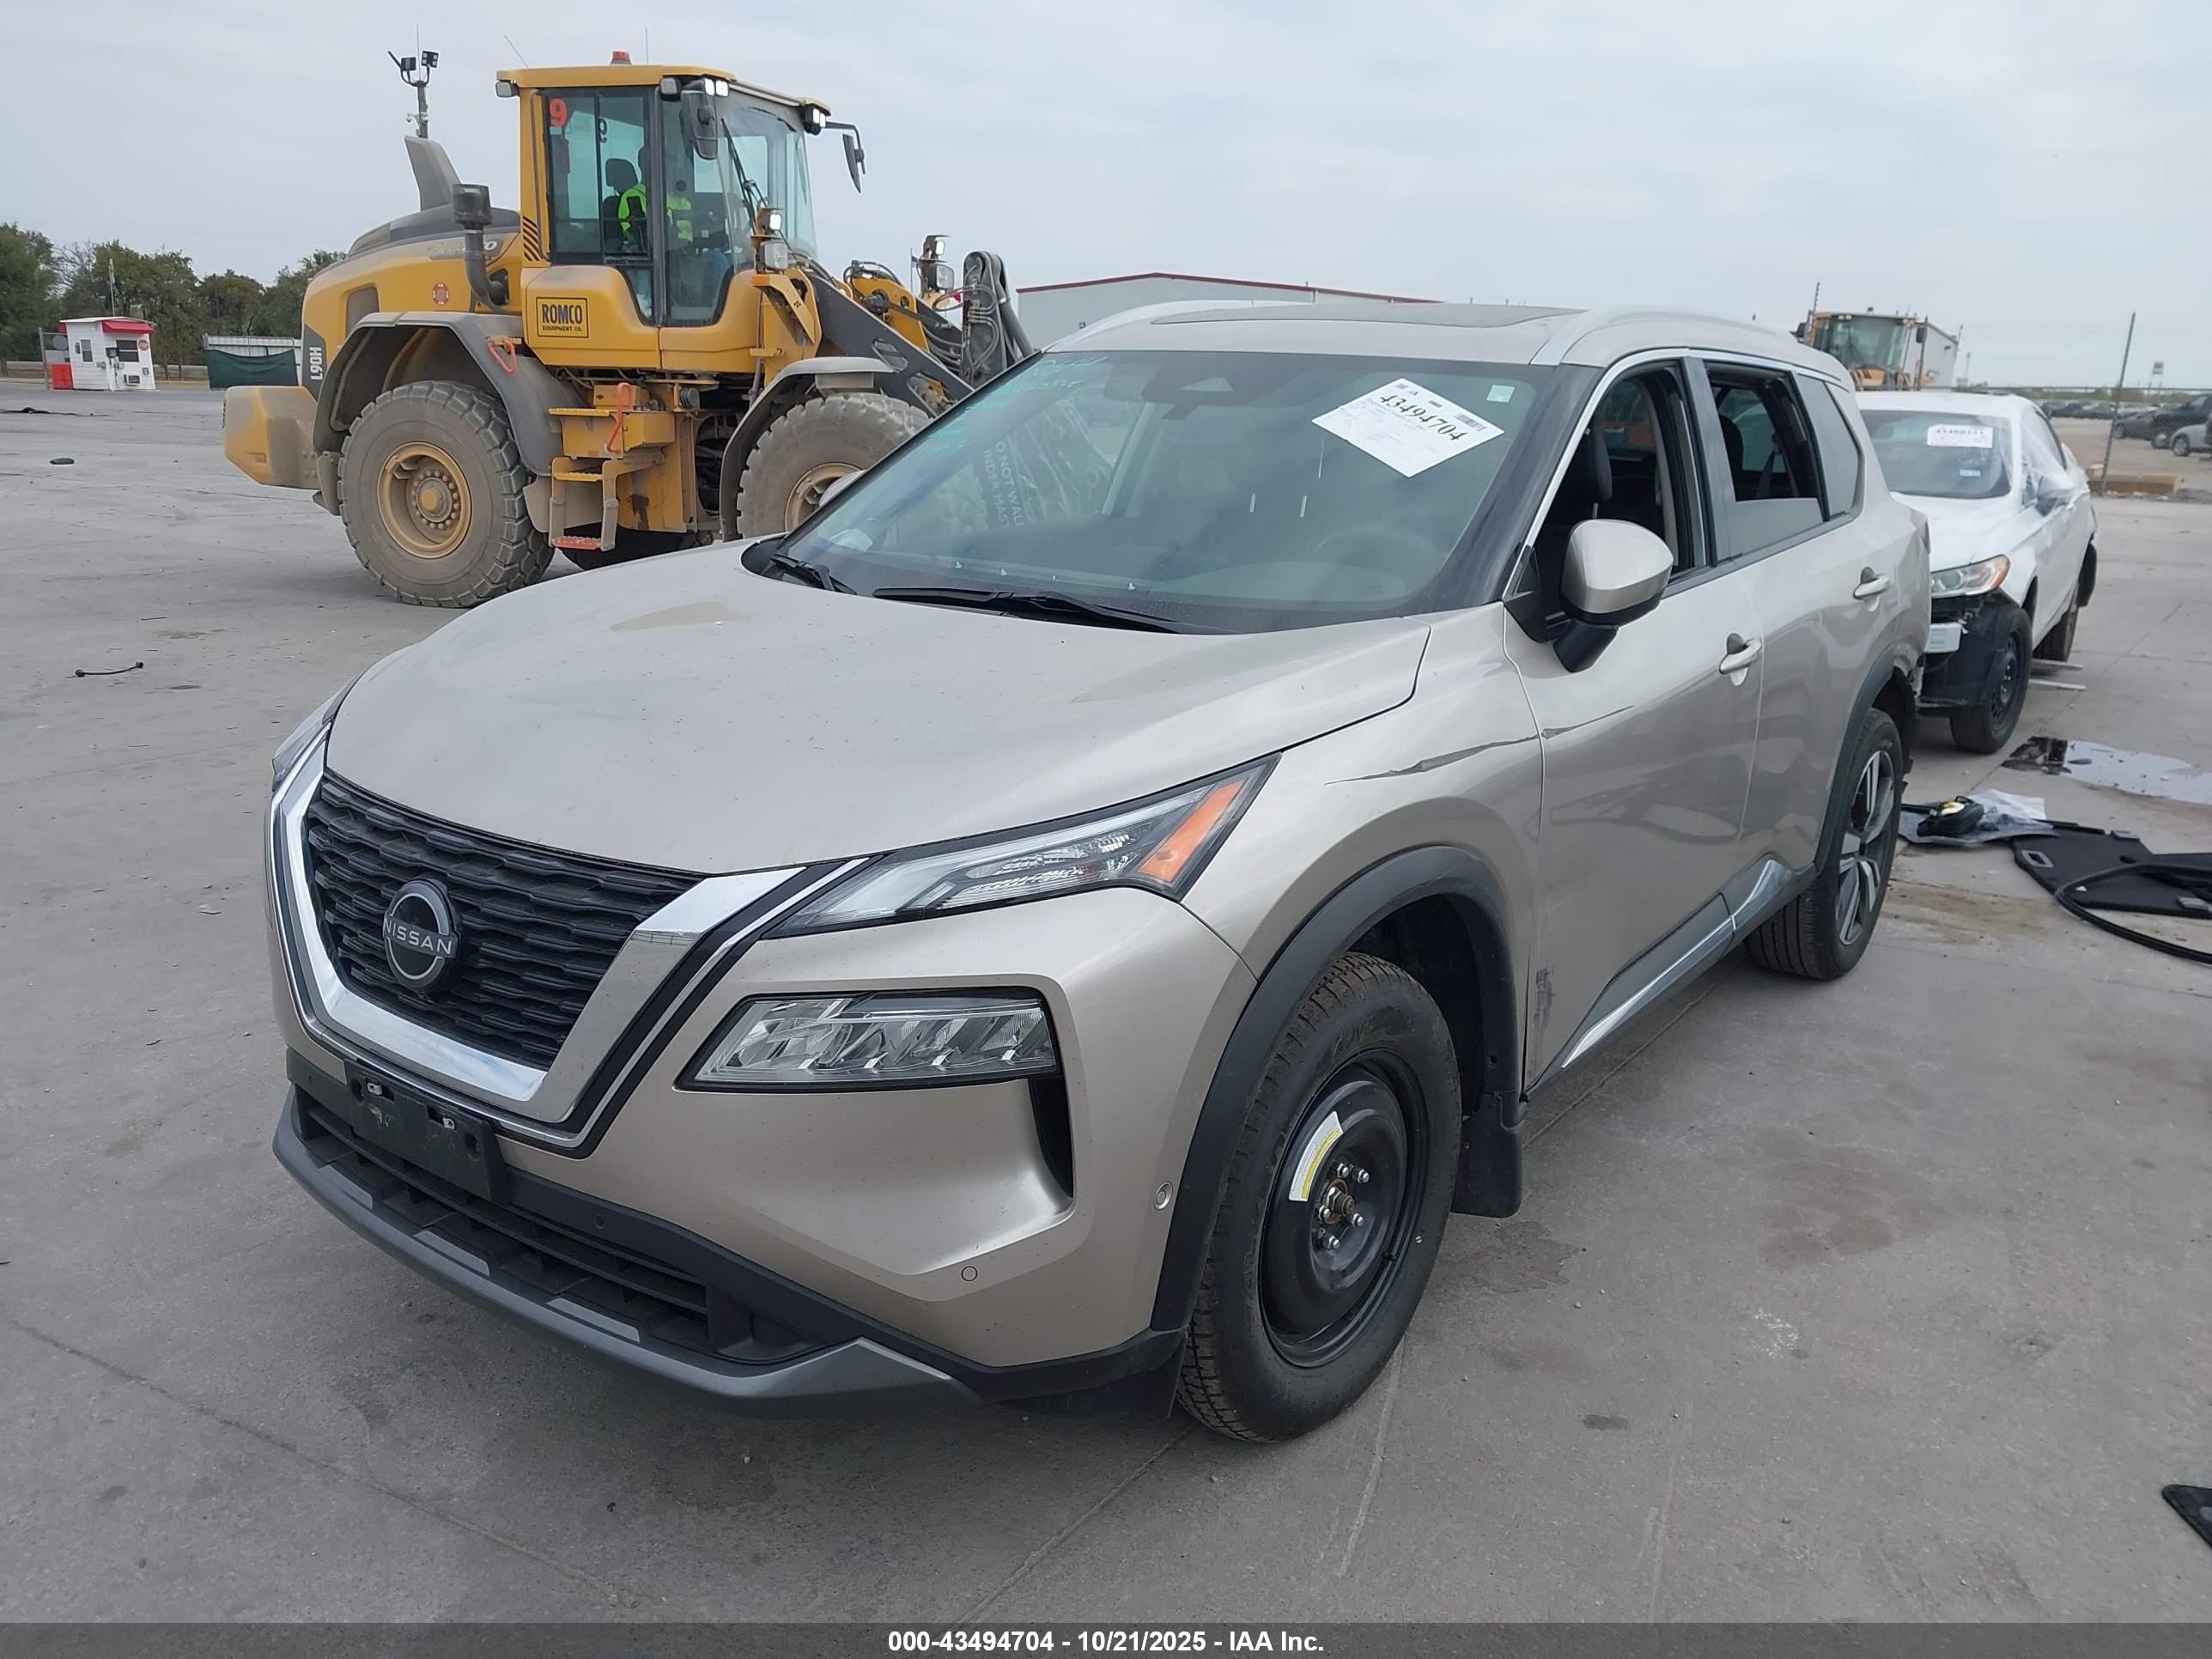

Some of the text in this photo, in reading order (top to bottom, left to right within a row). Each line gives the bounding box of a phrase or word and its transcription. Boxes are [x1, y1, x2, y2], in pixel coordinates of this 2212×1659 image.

[549, 98, 568, 127] 9
[542, 304, 583, 324] ROMCO
[309, 346, 324, 380] L90H
[1379, 395, 1468, 441] 43494704
[999, 455, 1015, 486] NOT
[383, 917, 453, 955] NISSAN
